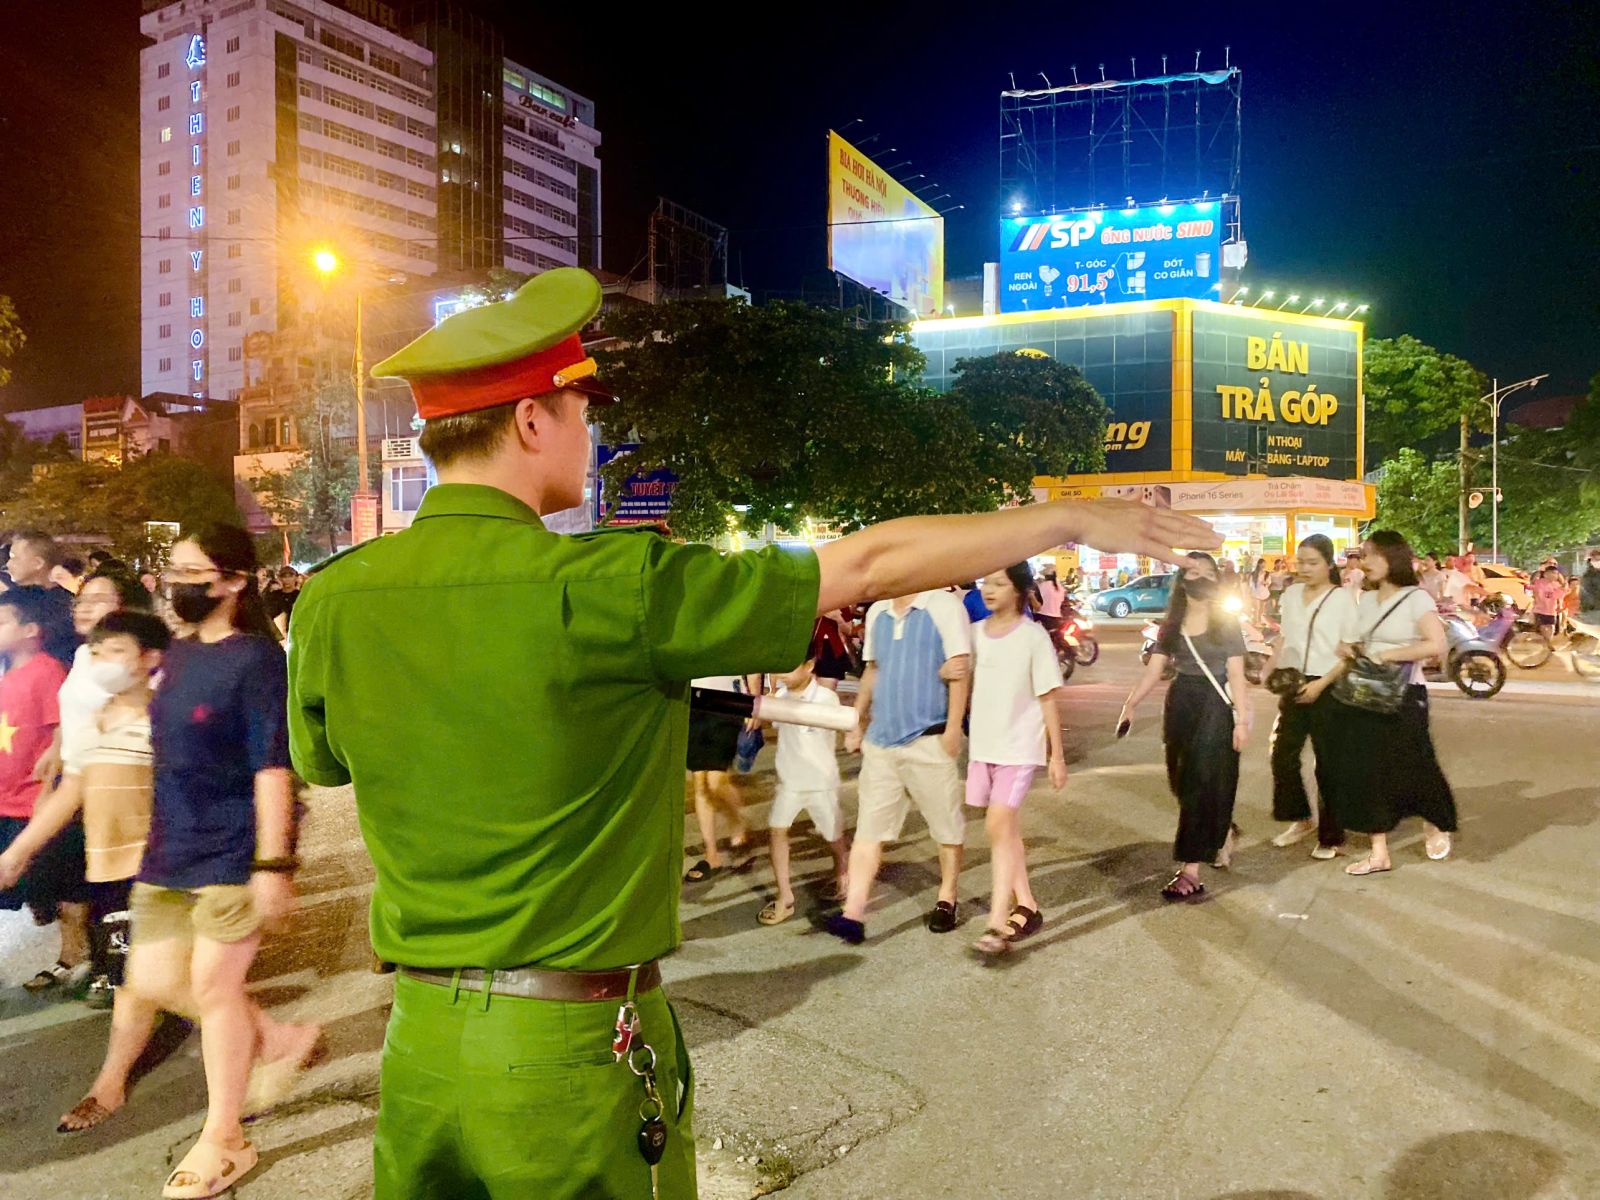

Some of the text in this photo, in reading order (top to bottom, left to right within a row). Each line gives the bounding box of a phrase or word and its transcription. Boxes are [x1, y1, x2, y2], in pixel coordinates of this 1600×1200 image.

[189, 80, 202, 229] THIEN
[1050, 219, 1214, 249] SP ỐNG NƯỚC SINO
[190, 250, 203, 272] Y
[1086, 258, 1107, 269] GÓC
[1014, 272, 1032, 281] REN
[1154, 268, 1194, 280] CO GIÃN
[1008, 281, 1037, 292] NGOÀI
[1247, 332, 1309, 375] BÁN
[1216, 377, 1338, 425] TRẢ GÓP
[1104, 421, 1152, 450] ng
[1276, 436, 1303, 449] THOẠI
[1225, 449, 1246, 462] MÁY
[1267, 450, 1292, 465] BẢNG
[1297, 455, 1330, 467] LAPTOP
[631, 478, 666, 497] TUYẾT
[1179, 491, 1206, 500] iPhone
